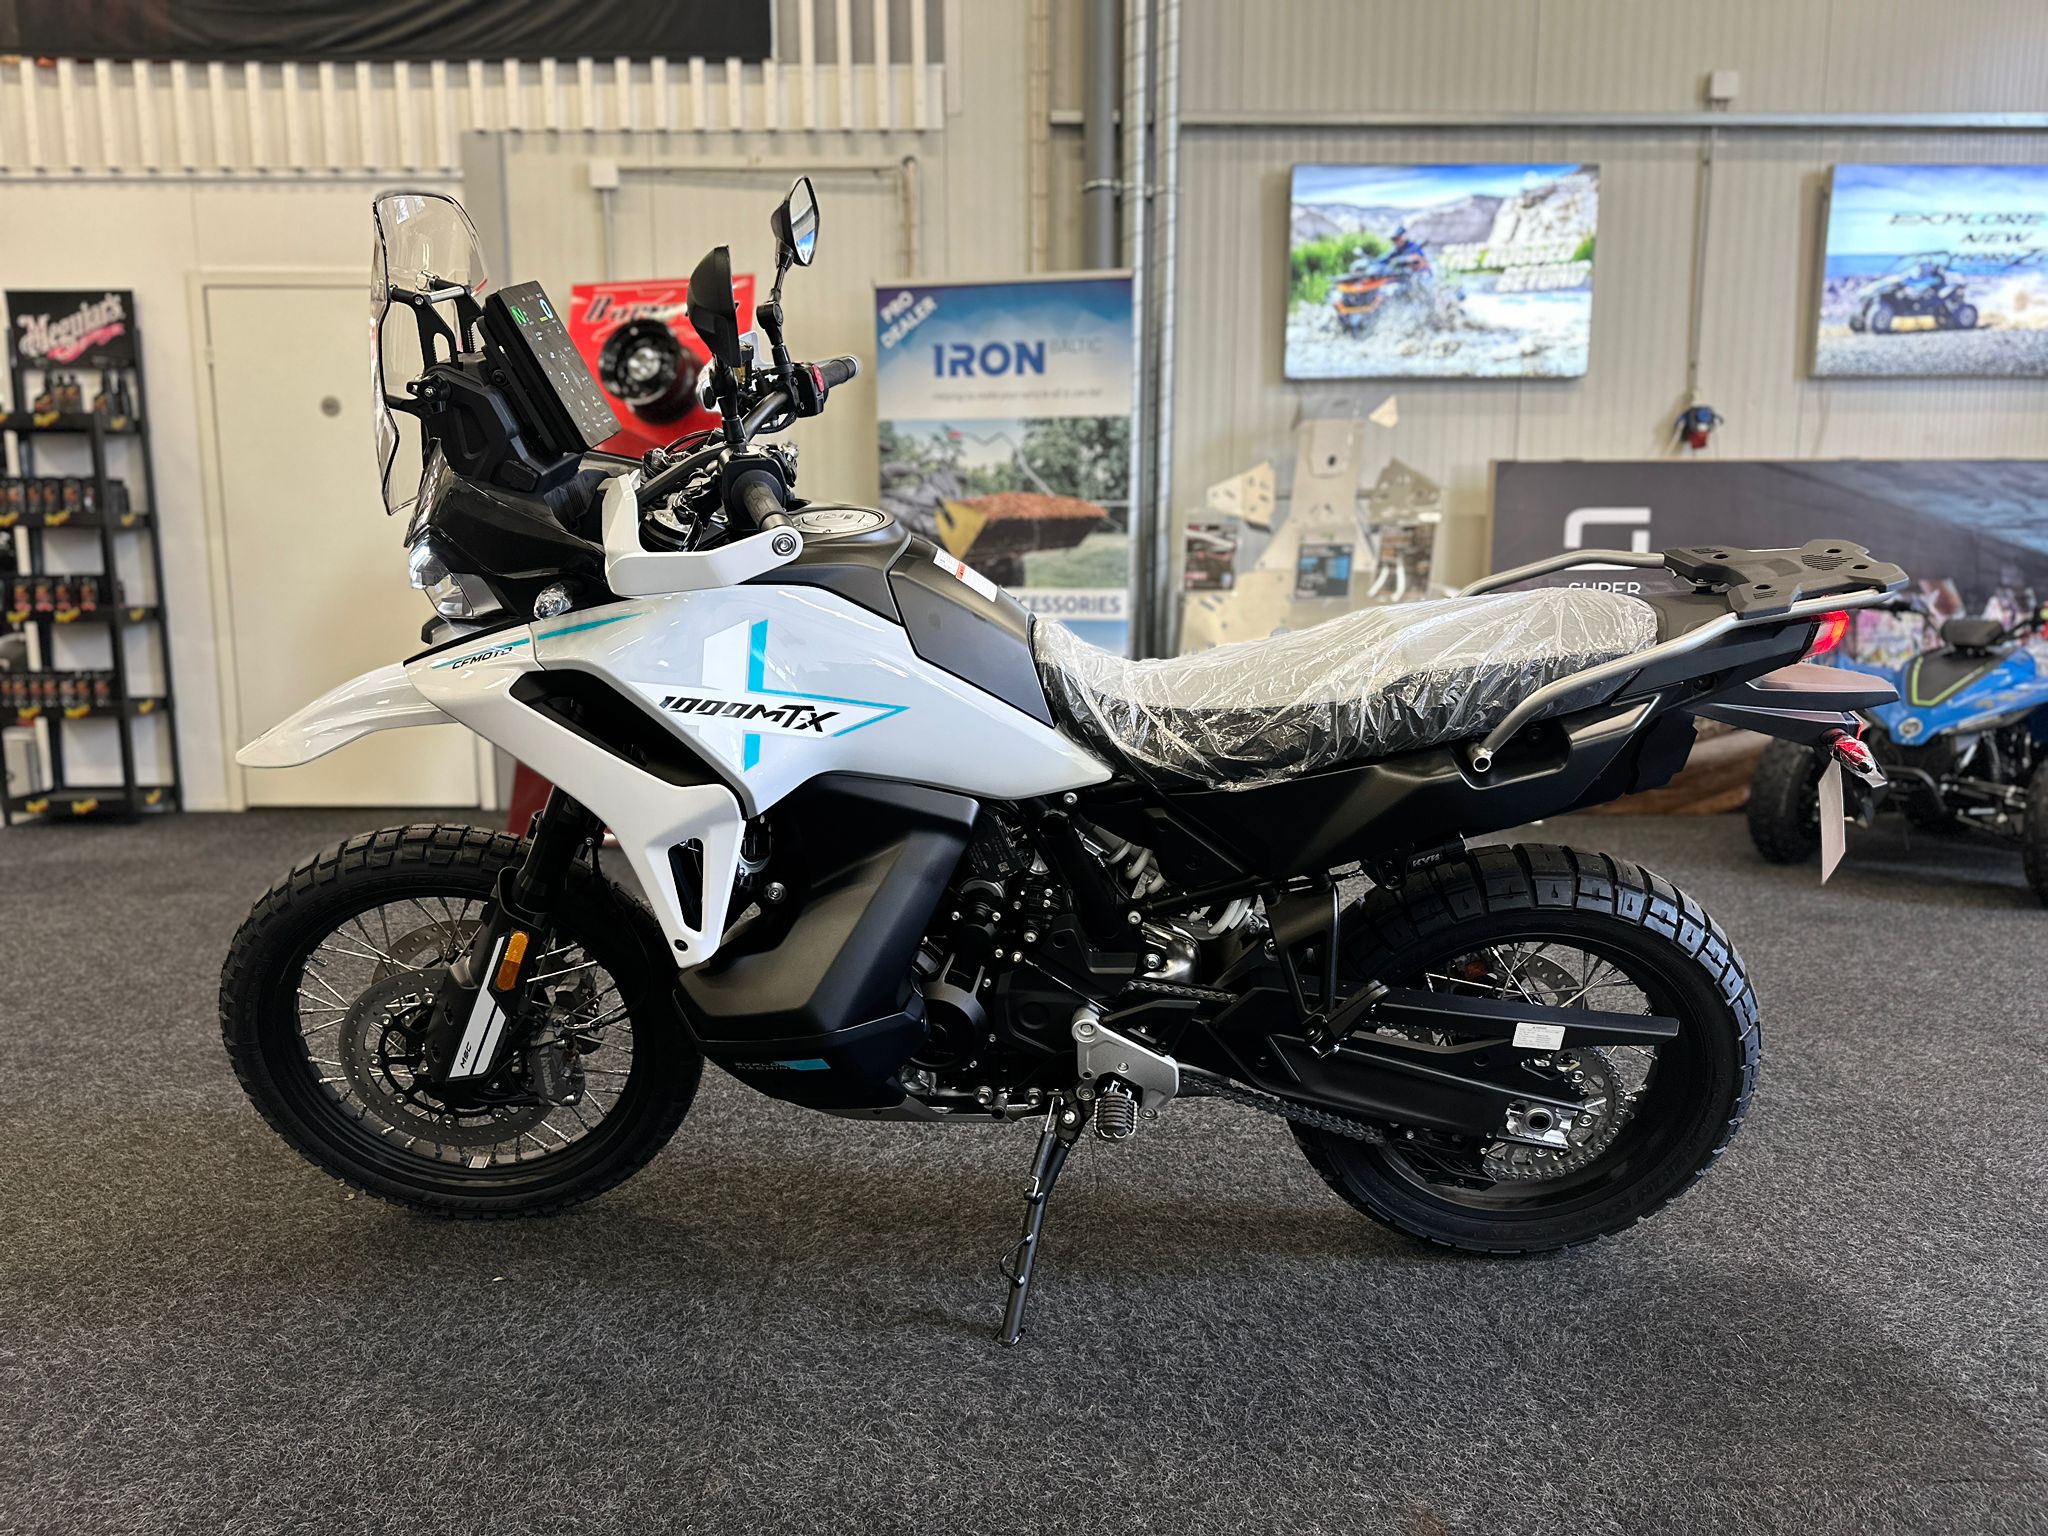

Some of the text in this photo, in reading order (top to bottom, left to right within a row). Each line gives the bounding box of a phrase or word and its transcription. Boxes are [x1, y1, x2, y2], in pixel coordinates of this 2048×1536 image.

[1889, 211, 2046, 227] EXPLORE
[1961, 231, 2033, 244] NEW
[511, 305, 527, 325] N
[880, 290, 914, 325] PRO
[880, 296, 938, 350] DEALER
[933, 340, 1046, 378] IRON
[452, 646, 513, 670] CFMOTO
